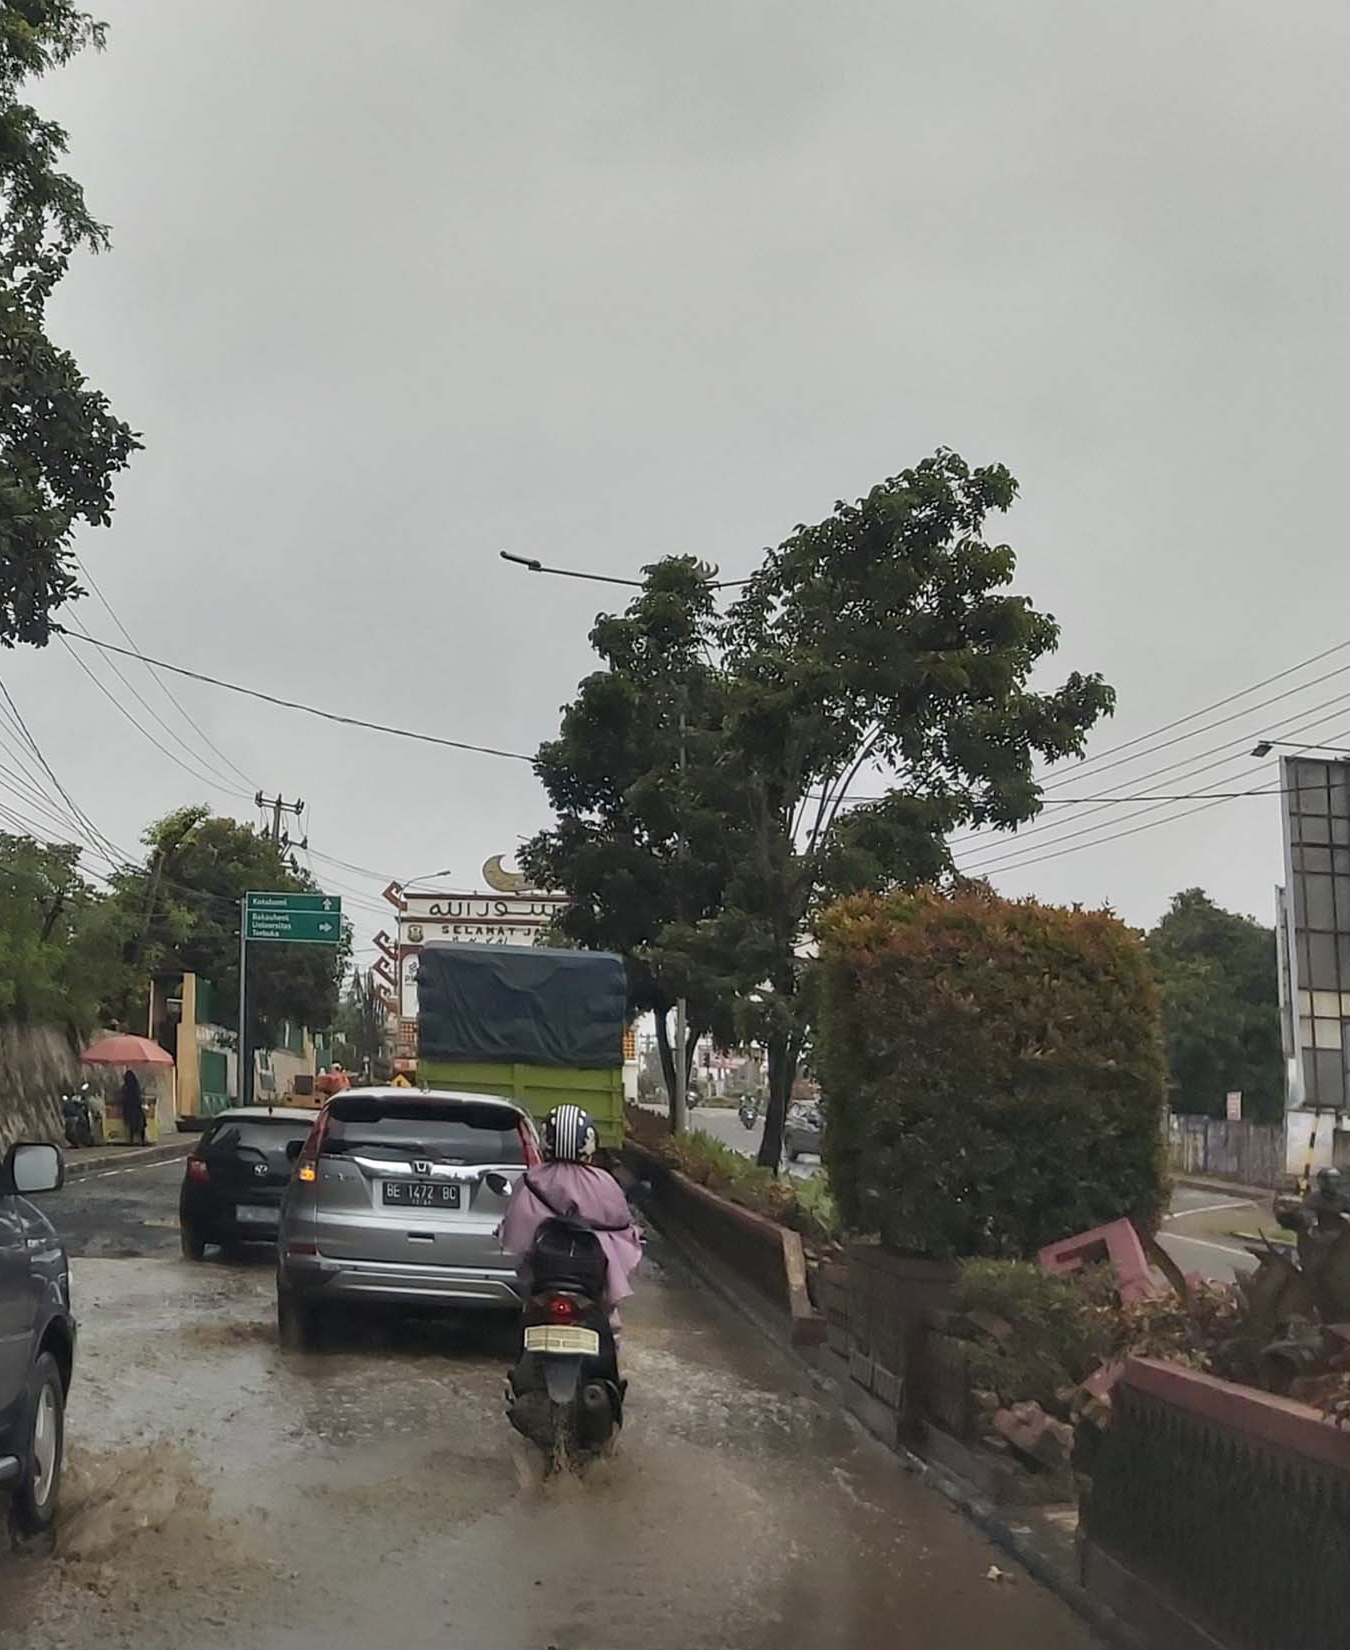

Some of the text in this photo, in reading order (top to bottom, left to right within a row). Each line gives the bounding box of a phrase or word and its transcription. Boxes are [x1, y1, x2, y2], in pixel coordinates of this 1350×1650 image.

[441, 924, 516, 936] SELAMAT
[386, 1183, 401, 1198] BE
[408, 1184, 434, 1199] 1472
